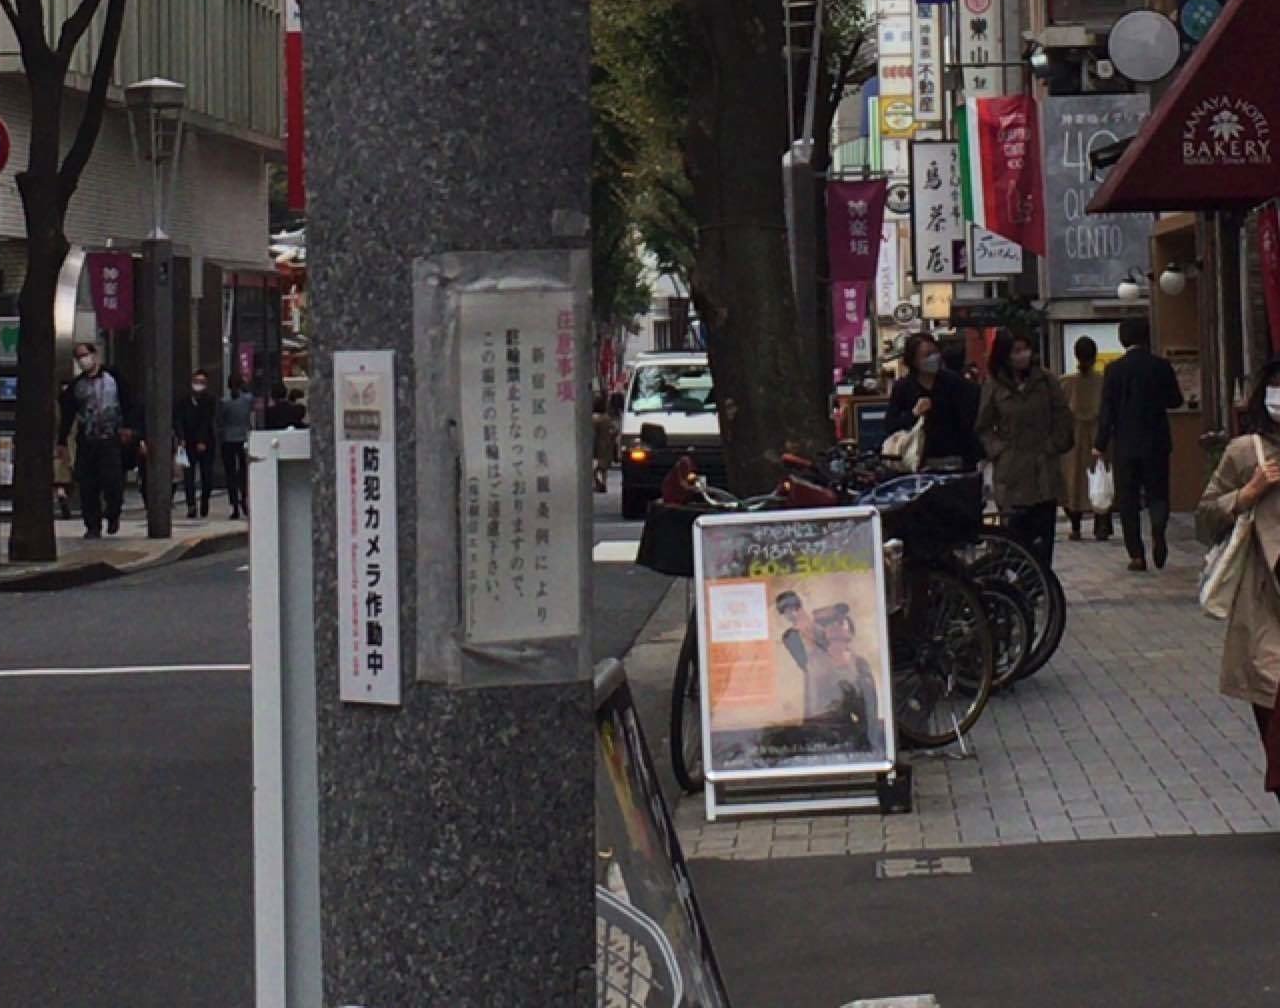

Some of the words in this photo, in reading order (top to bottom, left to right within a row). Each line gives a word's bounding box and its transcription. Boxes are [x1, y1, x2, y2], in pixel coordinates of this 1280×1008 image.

[1183, 95, 1232, 140] KANAYA
[1183, 140, 1271, 157] BAKERY
[846, 199, 870, 257] 神楽坂
[1066, 225, 1123, 259] CENTO
[557, 309, 577, 403] 注意事項
[362, 445, 385, 677] 防犯カメラ作動中
